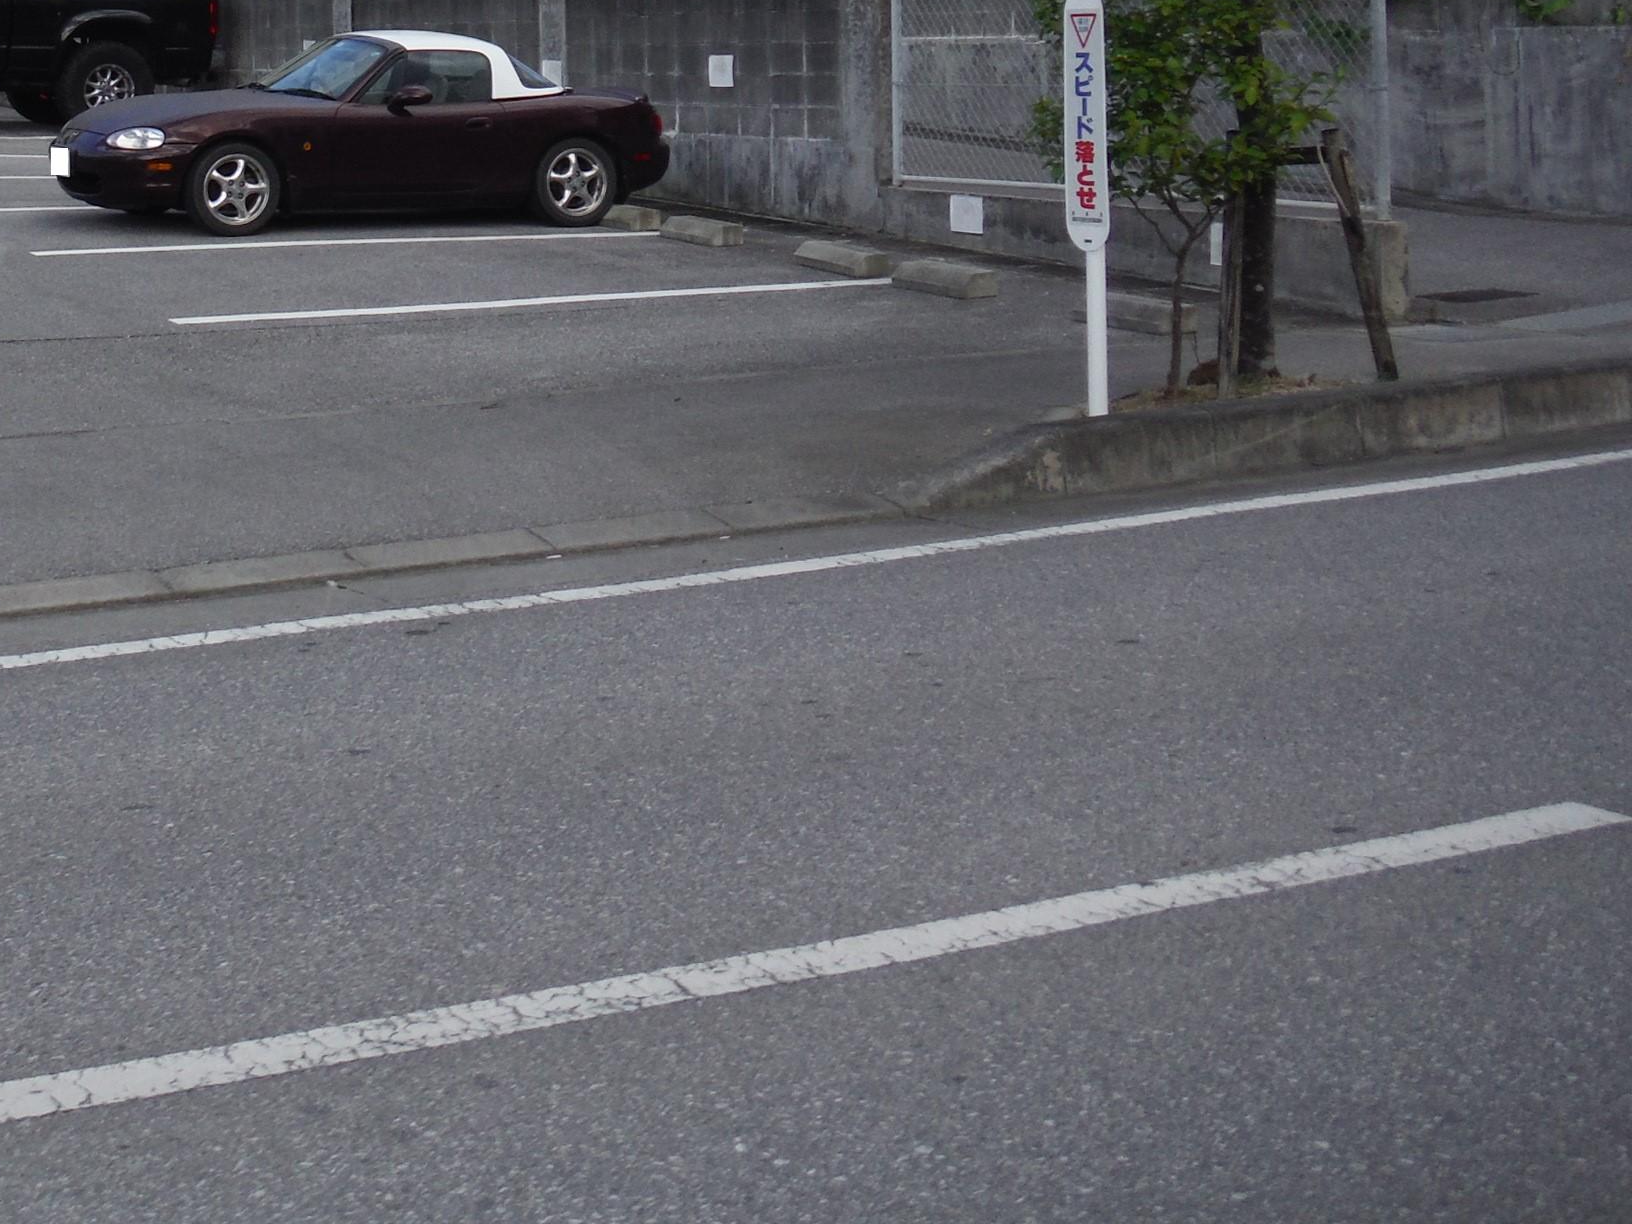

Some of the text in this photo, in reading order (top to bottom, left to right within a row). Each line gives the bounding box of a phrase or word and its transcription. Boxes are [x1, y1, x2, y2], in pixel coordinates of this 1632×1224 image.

[1074, 52, 1097, 210] スピード落とせ
